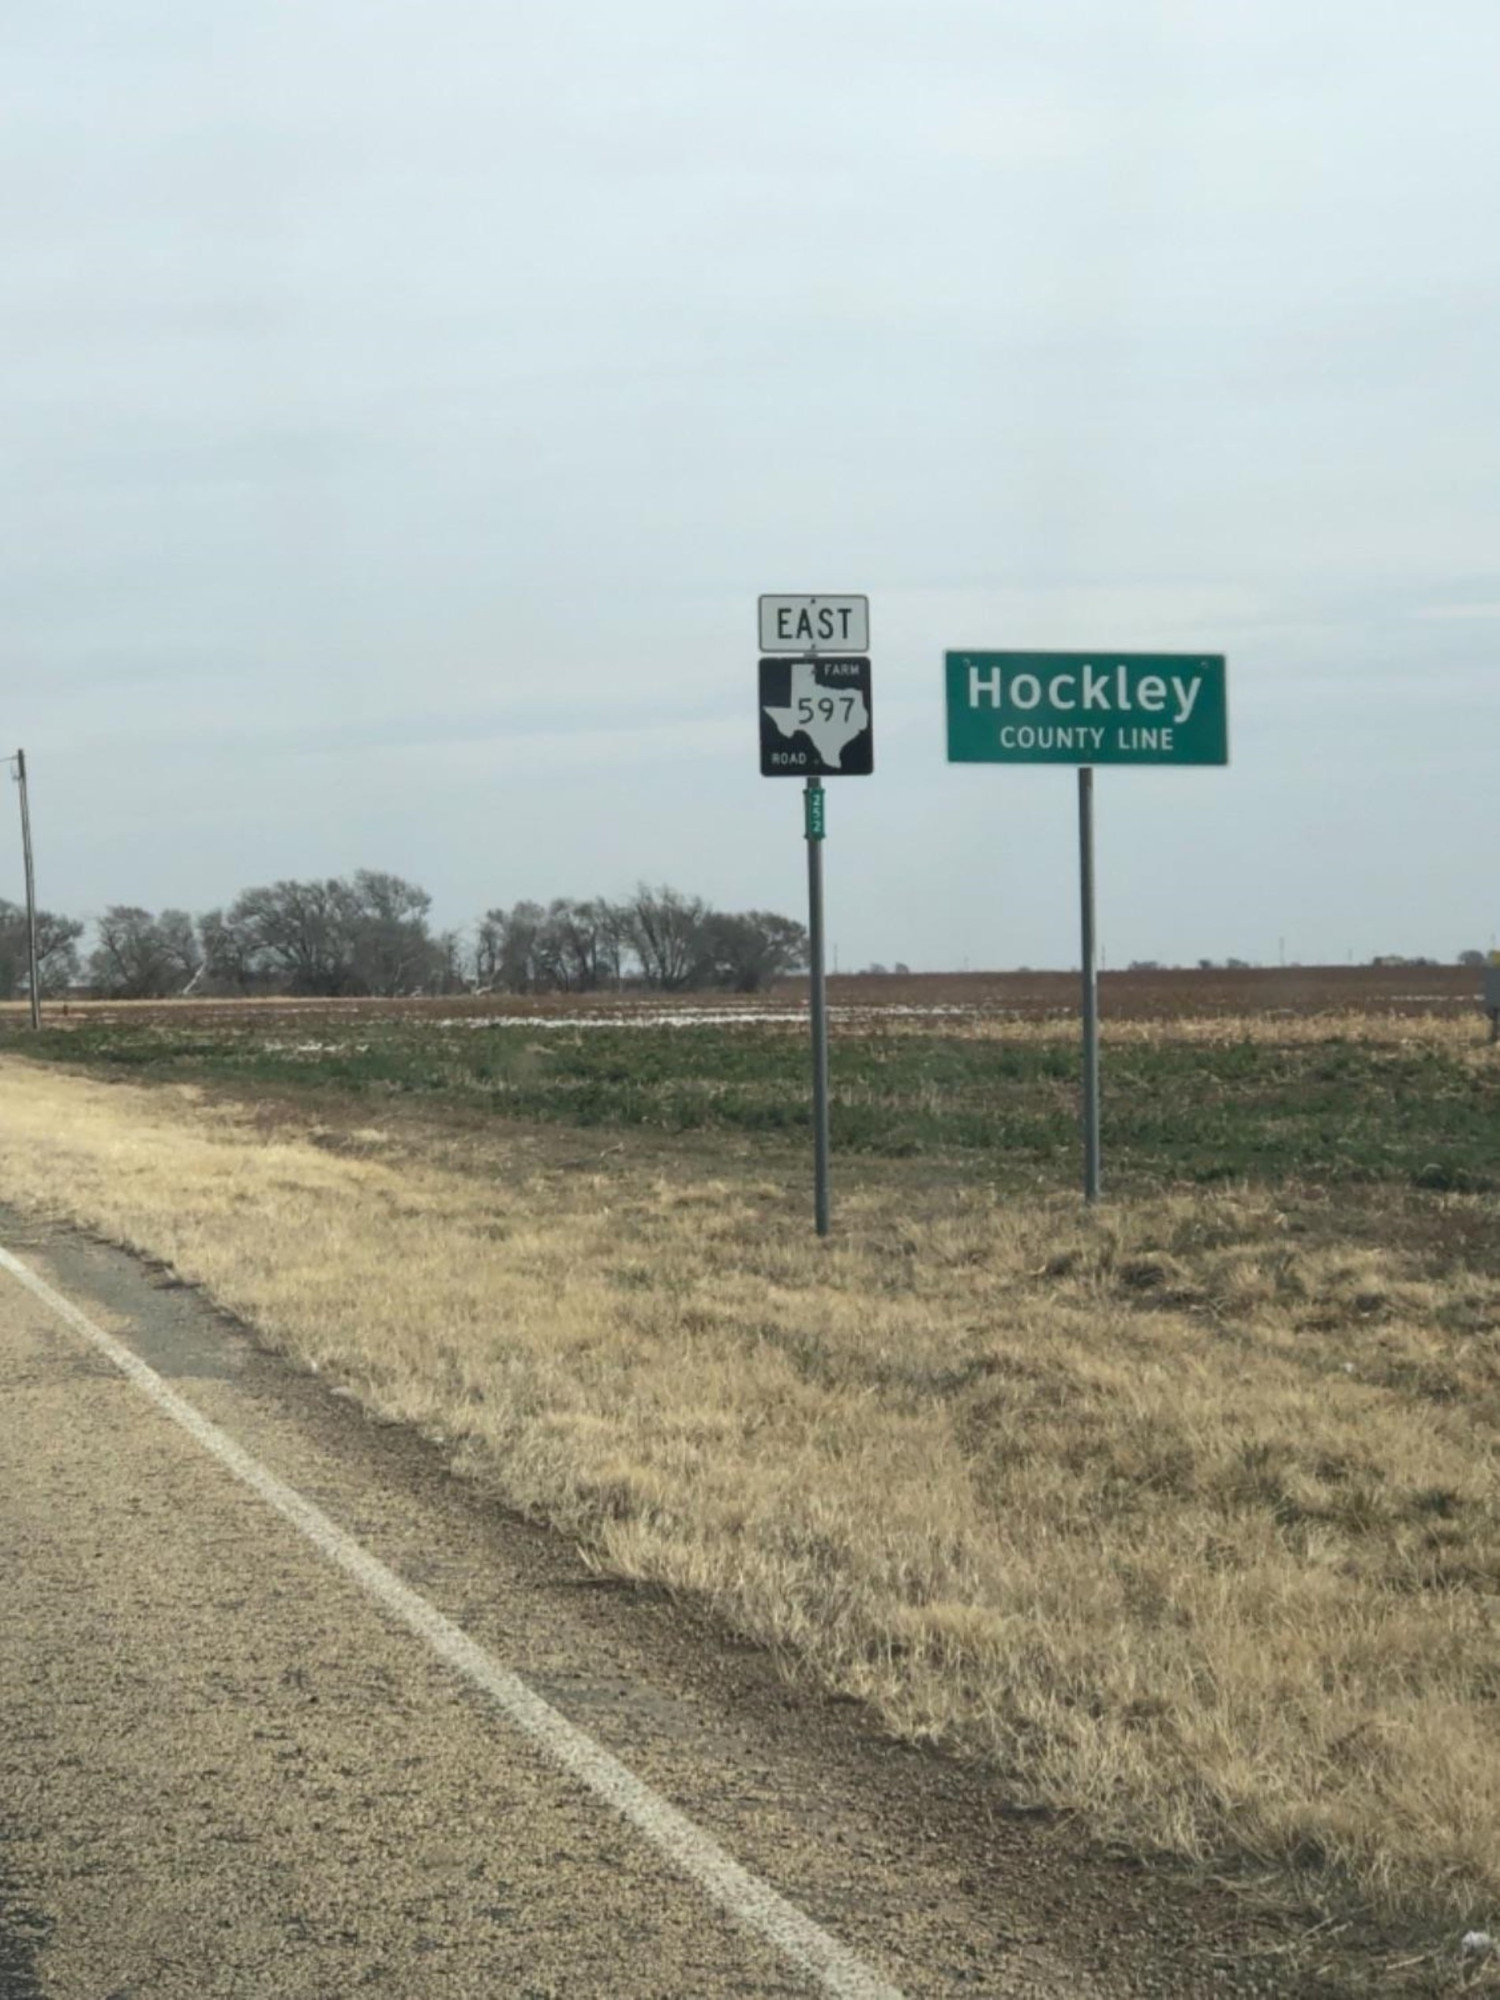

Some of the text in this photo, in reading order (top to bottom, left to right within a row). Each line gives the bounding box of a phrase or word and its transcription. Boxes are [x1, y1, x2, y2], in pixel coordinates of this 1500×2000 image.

[777, 608, 852, 639] EAST
[824, 664, 860, 675] FARM
[969, 665, 1202, 723] Hockley
[798, 697, 855, 724] 597
[1000, 726, 1173, 749] COUNTY LINE
[771, 753, 807, 764] ROAD
